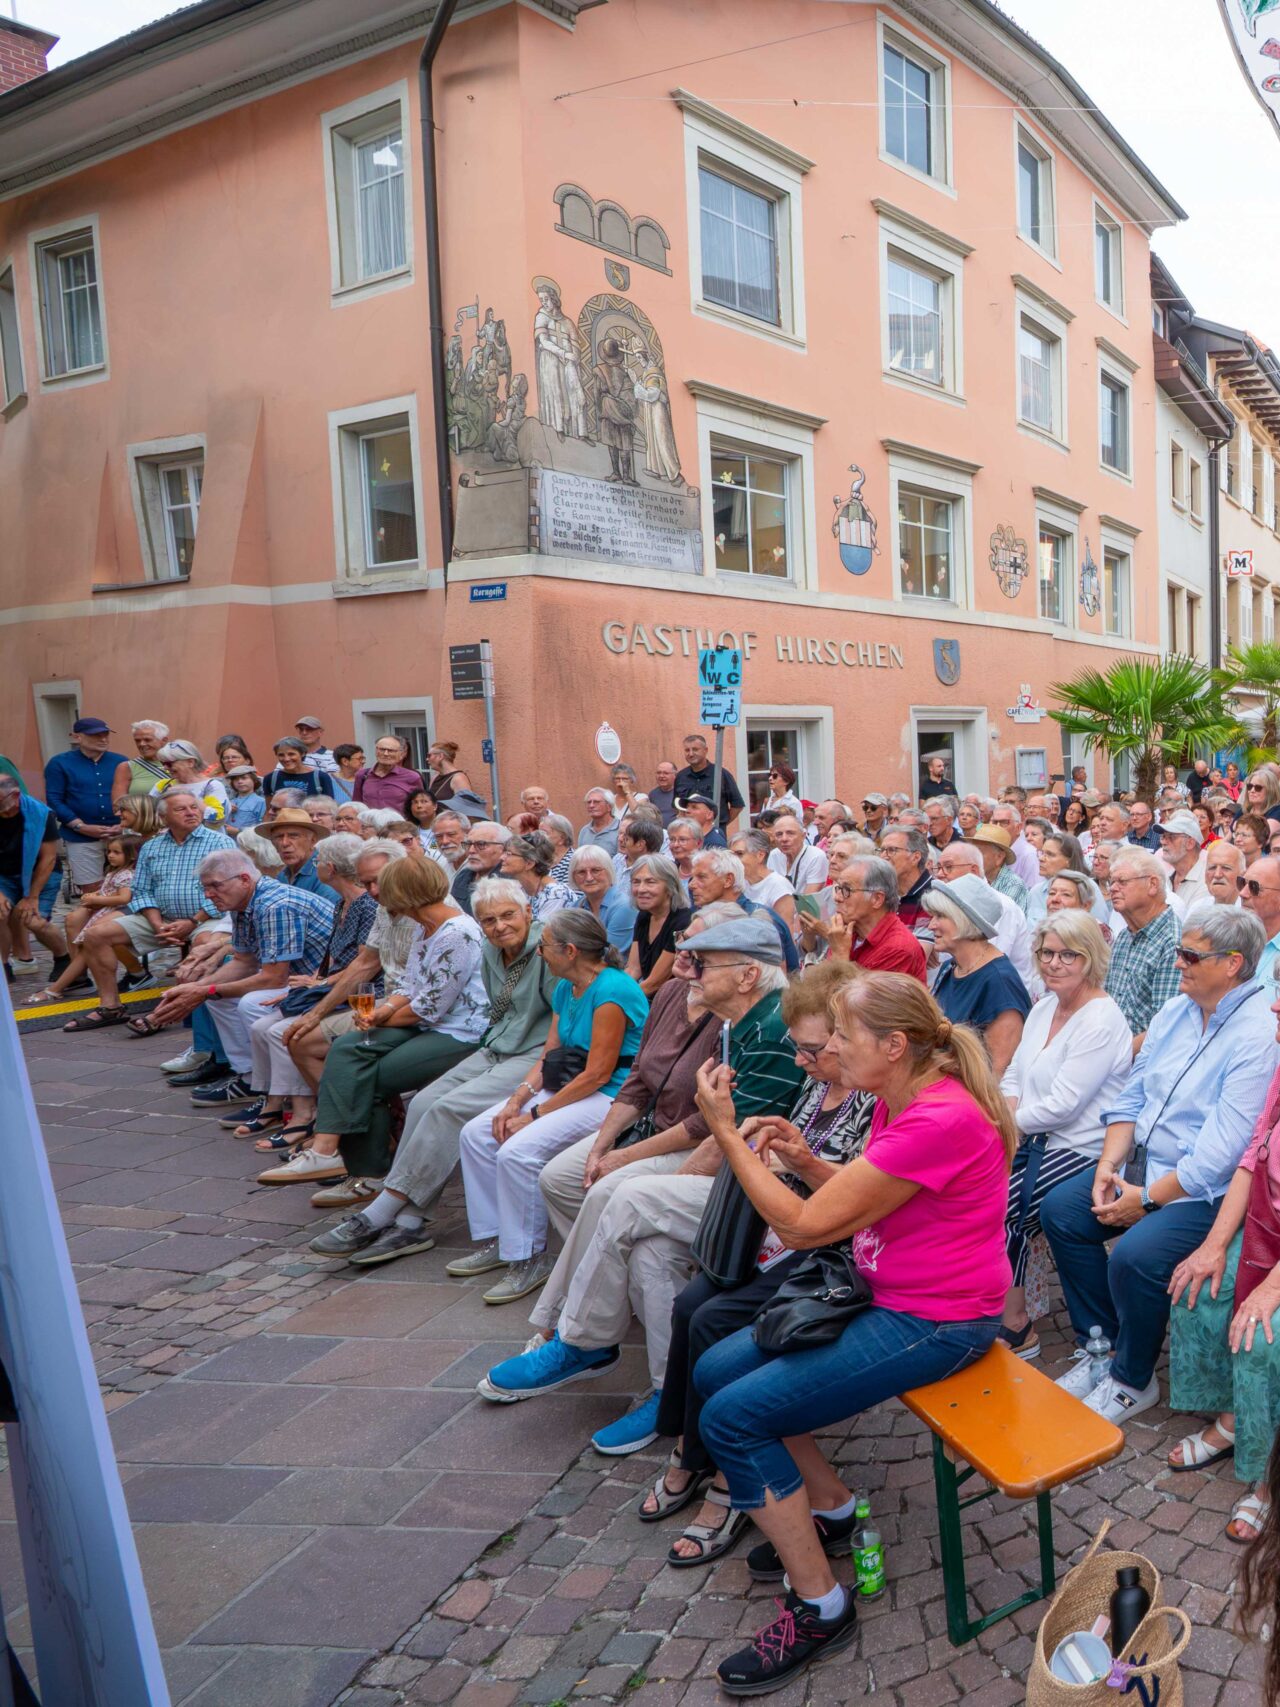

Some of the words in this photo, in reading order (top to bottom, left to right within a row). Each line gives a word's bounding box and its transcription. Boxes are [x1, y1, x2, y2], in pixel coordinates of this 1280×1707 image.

[1234, 557, 1247, 568] M
[602, 621, 757, 660] GASTHOF
[776, 634, 904, 668] HIRSCHEN
